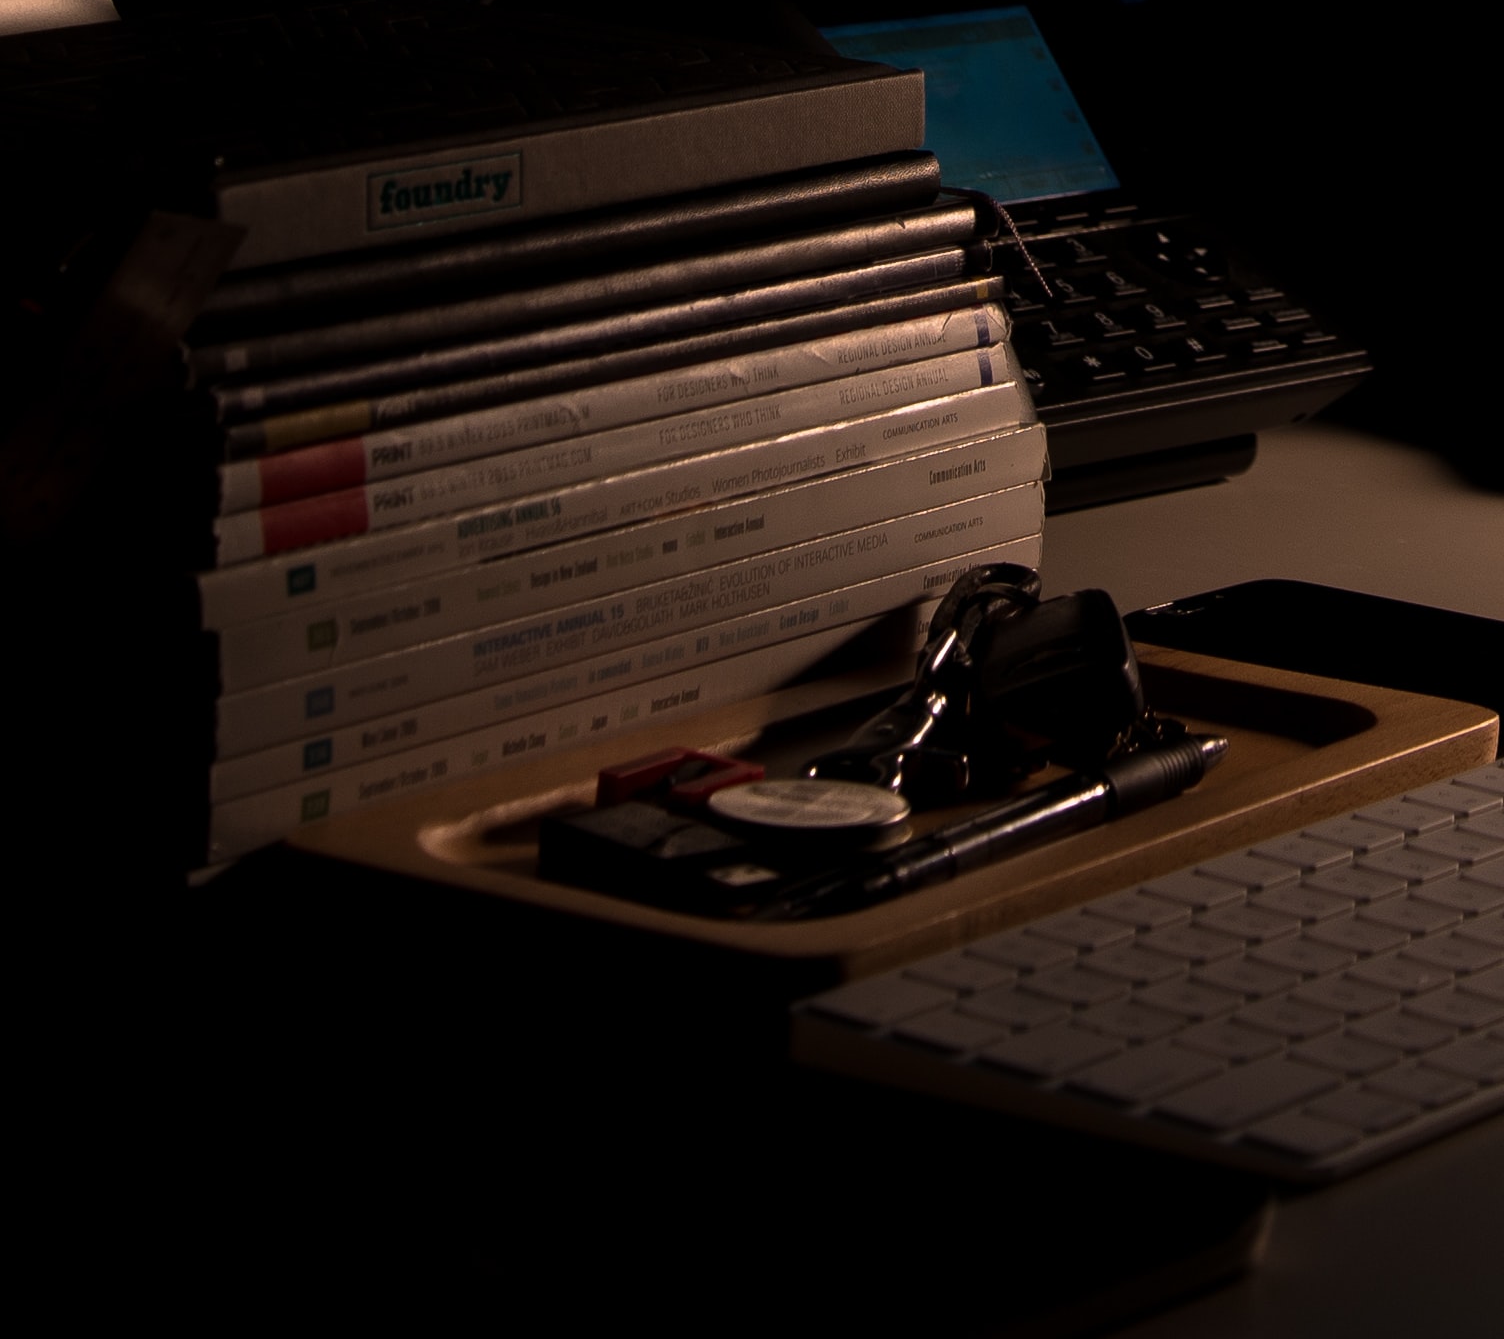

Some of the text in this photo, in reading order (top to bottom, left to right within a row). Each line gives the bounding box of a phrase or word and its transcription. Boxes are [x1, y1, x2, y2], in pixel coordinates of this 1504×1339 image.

[380, 169, 511, 213] foundry
[371, 439, 412, 465] PRINT
[657, 384, 676, 403] FOR
[678, 376, 728, 399] DESIGNERS
[752, 365, 779, 384] THINK
[838, 345, 880, 364] REGIONAL
[882, 339, 912, 357] DESIGN
[373, 370, 949, 512] PRINT FOR DESIGNERS WHO THINK REGIONAL DESIGN ANNUAL
[712, 474, 749, 493] Women
[752, 454, 825, 485] Photojournalists
[836, 444, 866, 463] Exhibit
[882, 420, 939, 440] COMMUNICATION
[941, 413, 958, 425] ARTS
[929, 459, 986, 485] Communication Arts
[473, 625, 552, 656] INTERACTIVE
[556, 612, 606, 634] ANNUAL
[719, 563, 777, 589] EVOLUTION
[793, 542, 855, 569] INTERACTIVE
[857, 533, 888, 552] MEDIA
[914, 521, 967, 543] COMMUNICATION
[969, 516, 983, 528] ARTS
